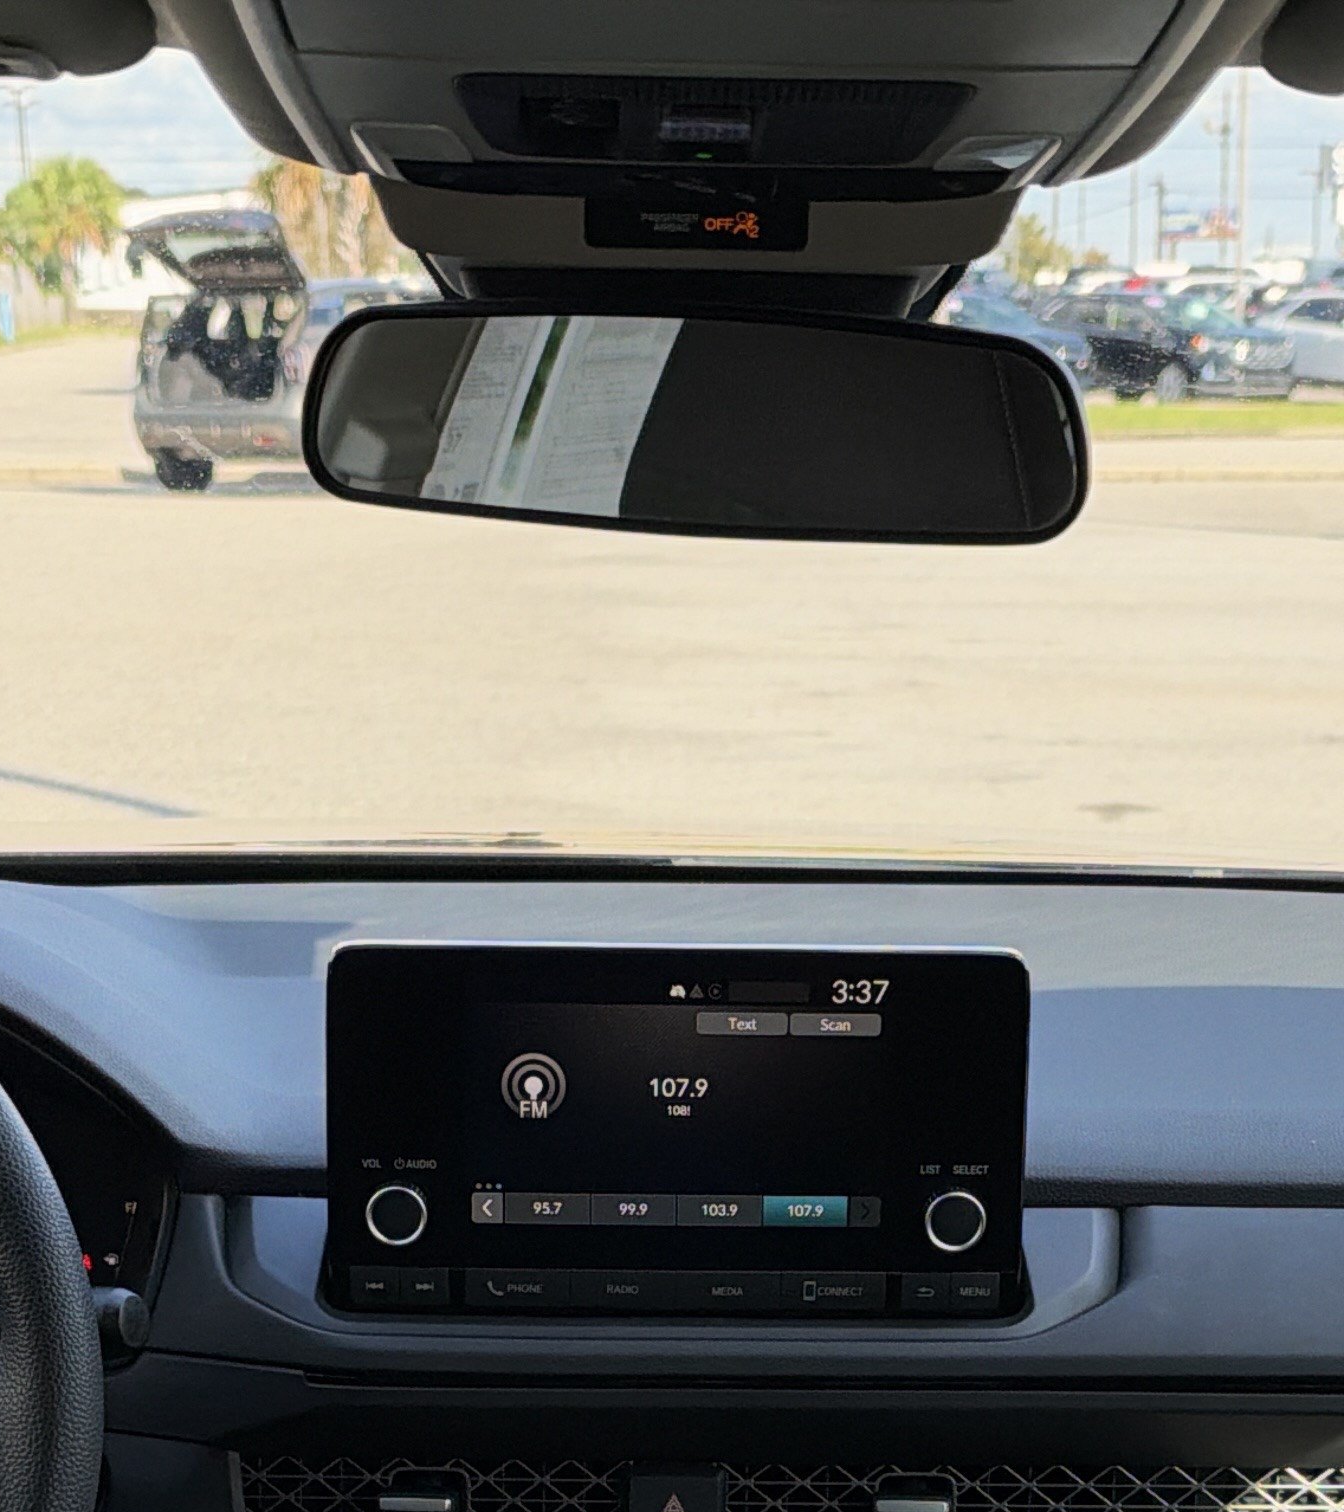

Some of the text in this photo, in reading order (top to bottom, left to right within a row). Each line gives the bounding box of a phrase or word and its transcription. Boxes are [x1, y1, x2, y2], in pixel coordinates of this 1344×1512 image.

[704, 217, 735, 232] OFF
[831, 979, 890, 1005] 3:37
[728, 1016, 757, 1031] Text
[820, 1018, 852, 1033] Scan
[649, 1077, 709, 1098] 107.9
[519, 1100, 548, 1119] FM
[667, 1104, 691, 1117] 108!
[361, 1159, 381, 1170] VOL
[405, 1159, 437, 1170] AUDIO
[919, 1164, 942, 1175] LIST
[952, 1164, 989, 1176] SELECT
[533, 1202, 563, 1215] 95.7
[619, 1203, 649, 1216] 99.9
[701, 1203, 738, 1217] 103.9
[787, 1204, 824, 1218] 107.9
[506, 1283, 544, 1294] PHONE
[606, 1284, 639, 1295] RADIO
[711, 1285, 744, 1297] MEDIA
[817, 1286, 864, 1298] CONNECT
[959, 1285, 991, 1297] MENU
